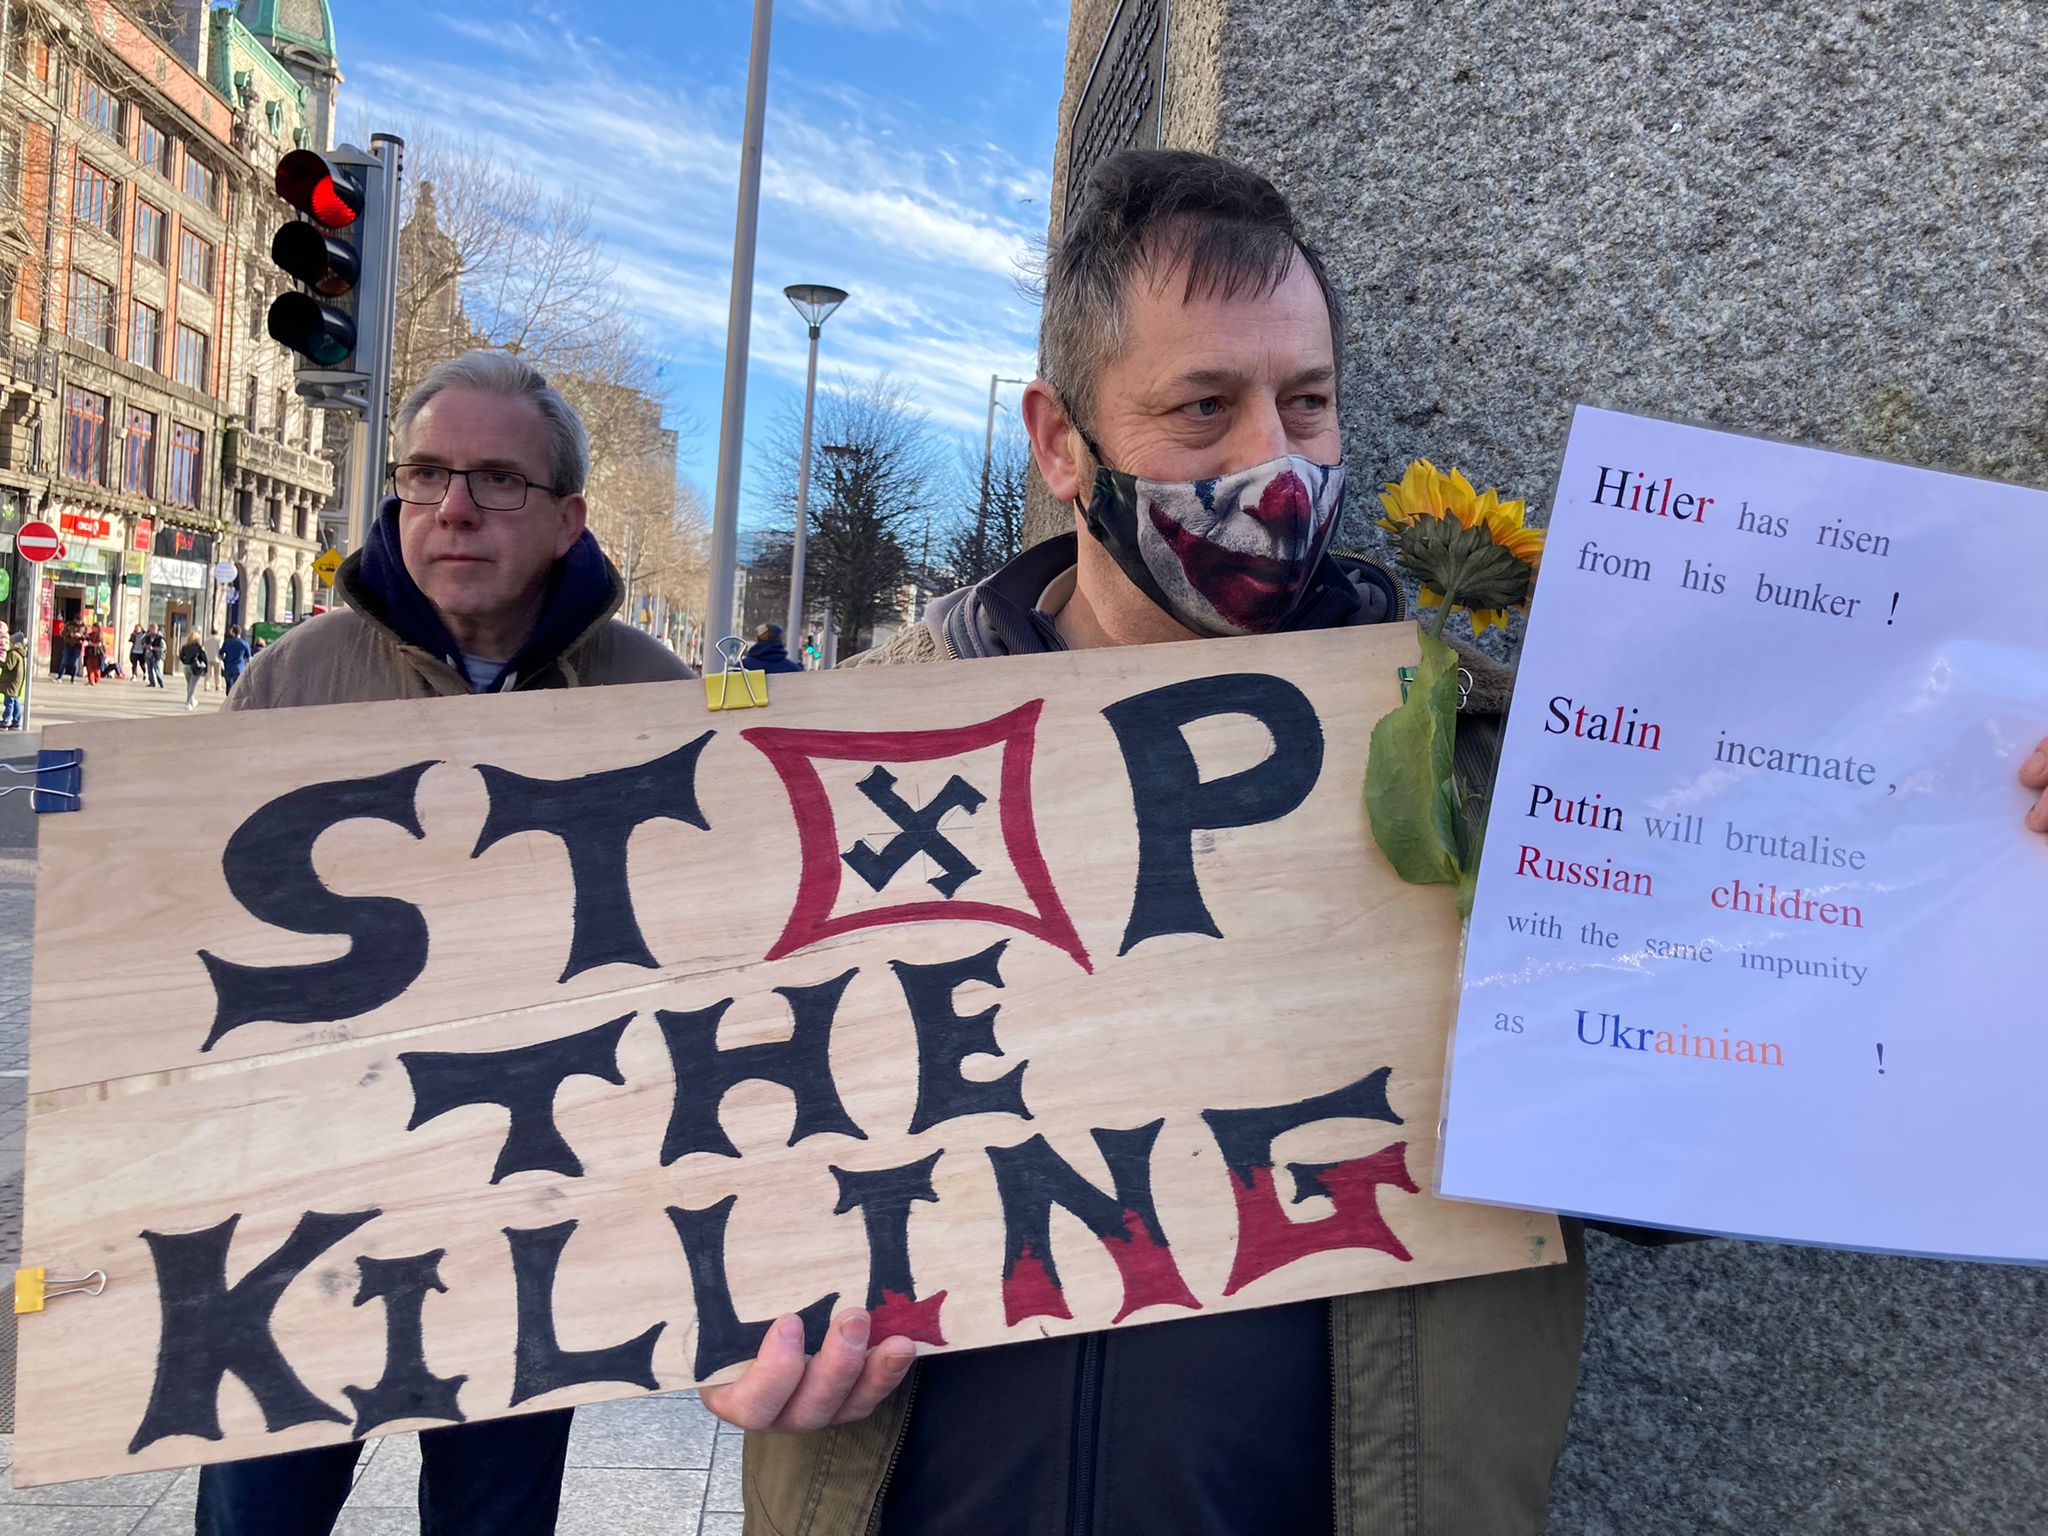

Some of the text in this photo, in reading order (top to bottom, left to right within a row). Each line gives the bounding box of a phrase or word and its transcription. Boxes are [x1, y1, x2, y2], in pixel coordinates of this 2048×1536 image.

[1590, 465, 1890, 556] Hitler has risen
[1577, 541, 1900, 625] from his bunker !
[1544, 696, 1661, 751] Stalin
[199, 672, 1325, 1053] STOP
[1525, 784, 1866, 870] Putin will brutalise
[1514, 844, 1863, 928] Russian children
[1507, 912, 1868, 987] with the same impunity
[398, 940, 1034, 1185] THE
[1494, 1009, 1886, 1075] as Ukrainian !
[127, 1066, 1422, 1455] KILLING
